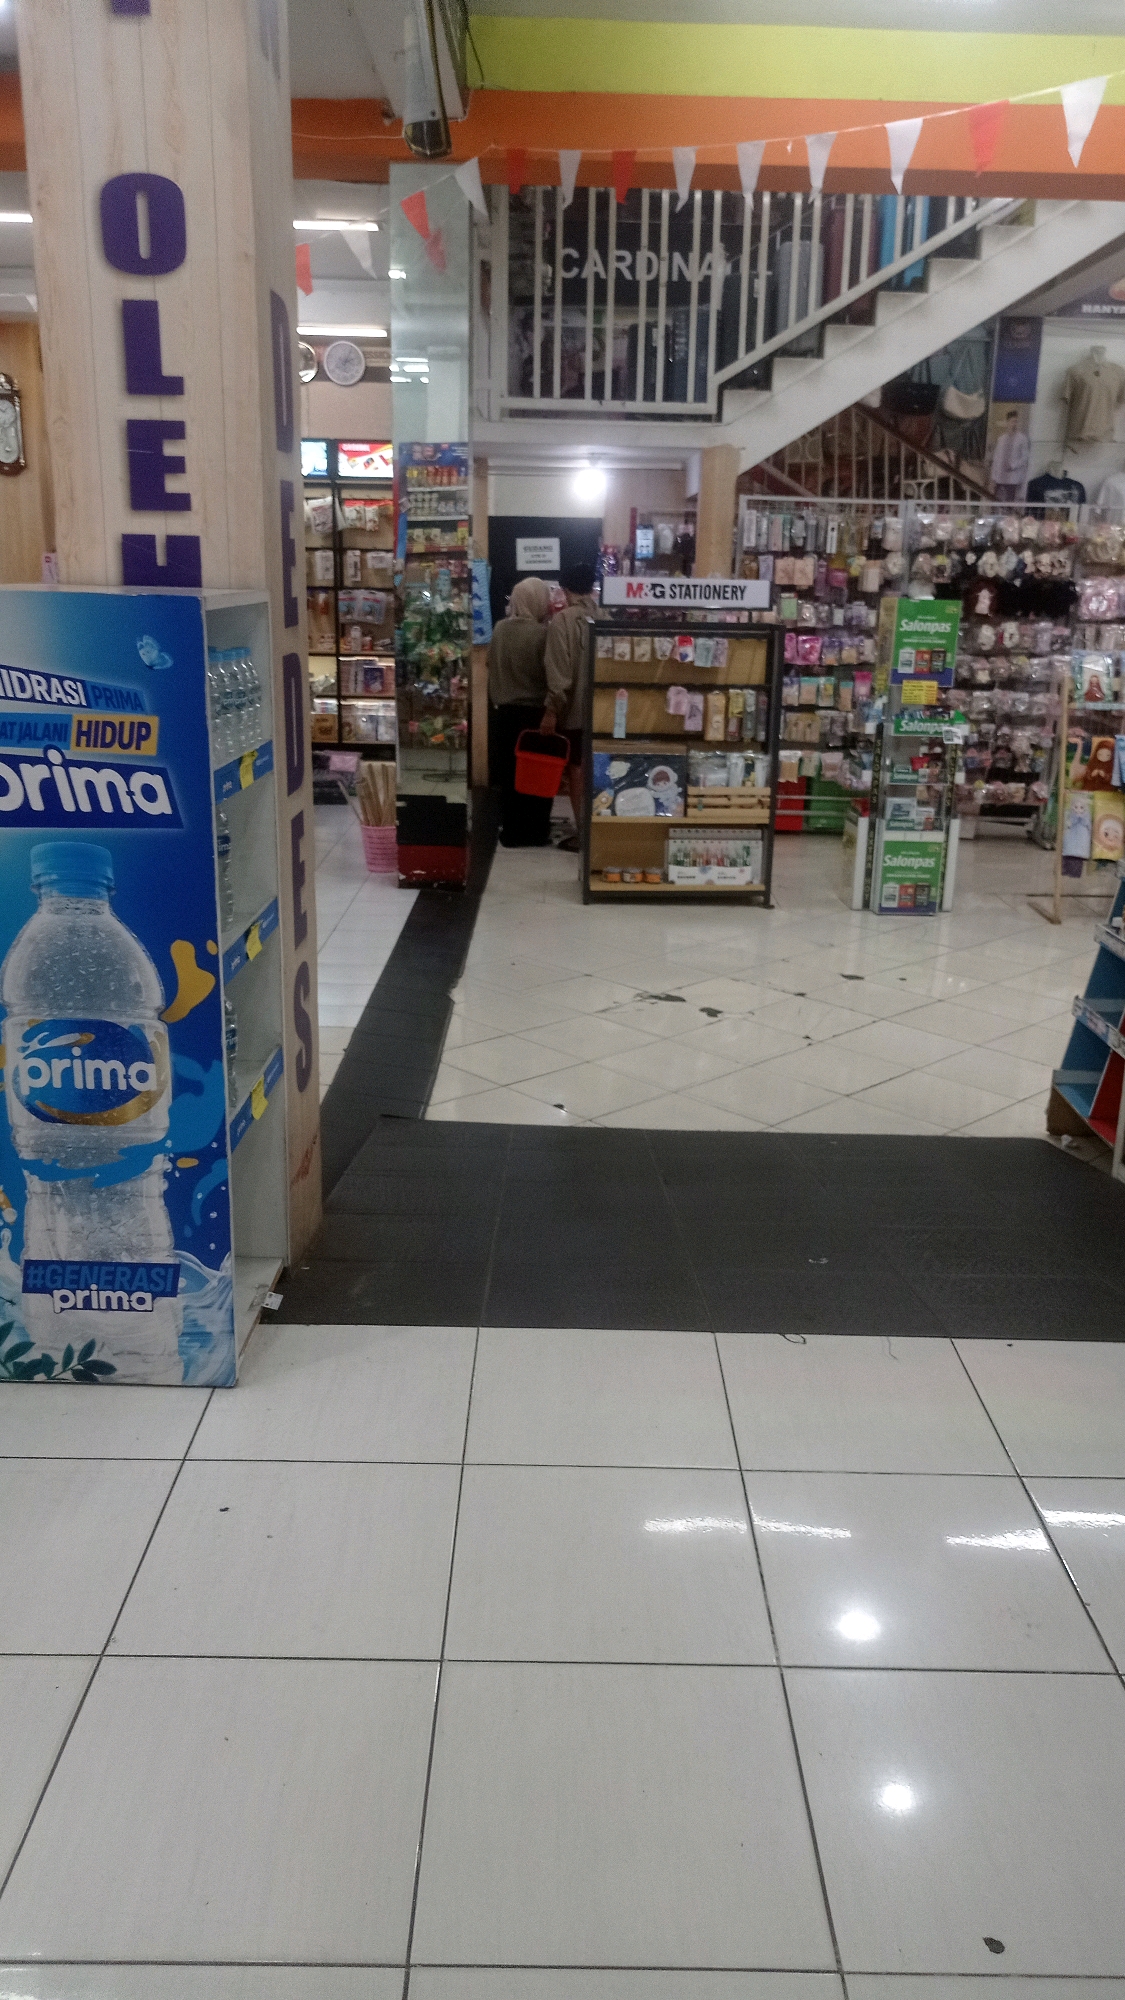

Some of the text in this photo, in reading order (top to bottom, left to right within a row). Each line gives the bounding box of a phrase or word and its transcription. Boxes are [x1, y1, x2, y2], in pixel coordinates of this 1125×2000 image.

[561, 248, 732, 282] CARDNA
[626, 582, 747, 601] M&G STATIONERY
[899, 618, 952, 635] Salonpas
[0, 667, 145, 712] IDRASI PRIMA
[18, 721, 68, 744] JALANI
[75, 719, 153, 751] HIDUP
[883, 854, 936, 869] Salonpas
[18, 1046, 158, 1096] prima
[26, 1264, 174, 1293] #GENERASI
[53, 1283, 153, 1313] prima
